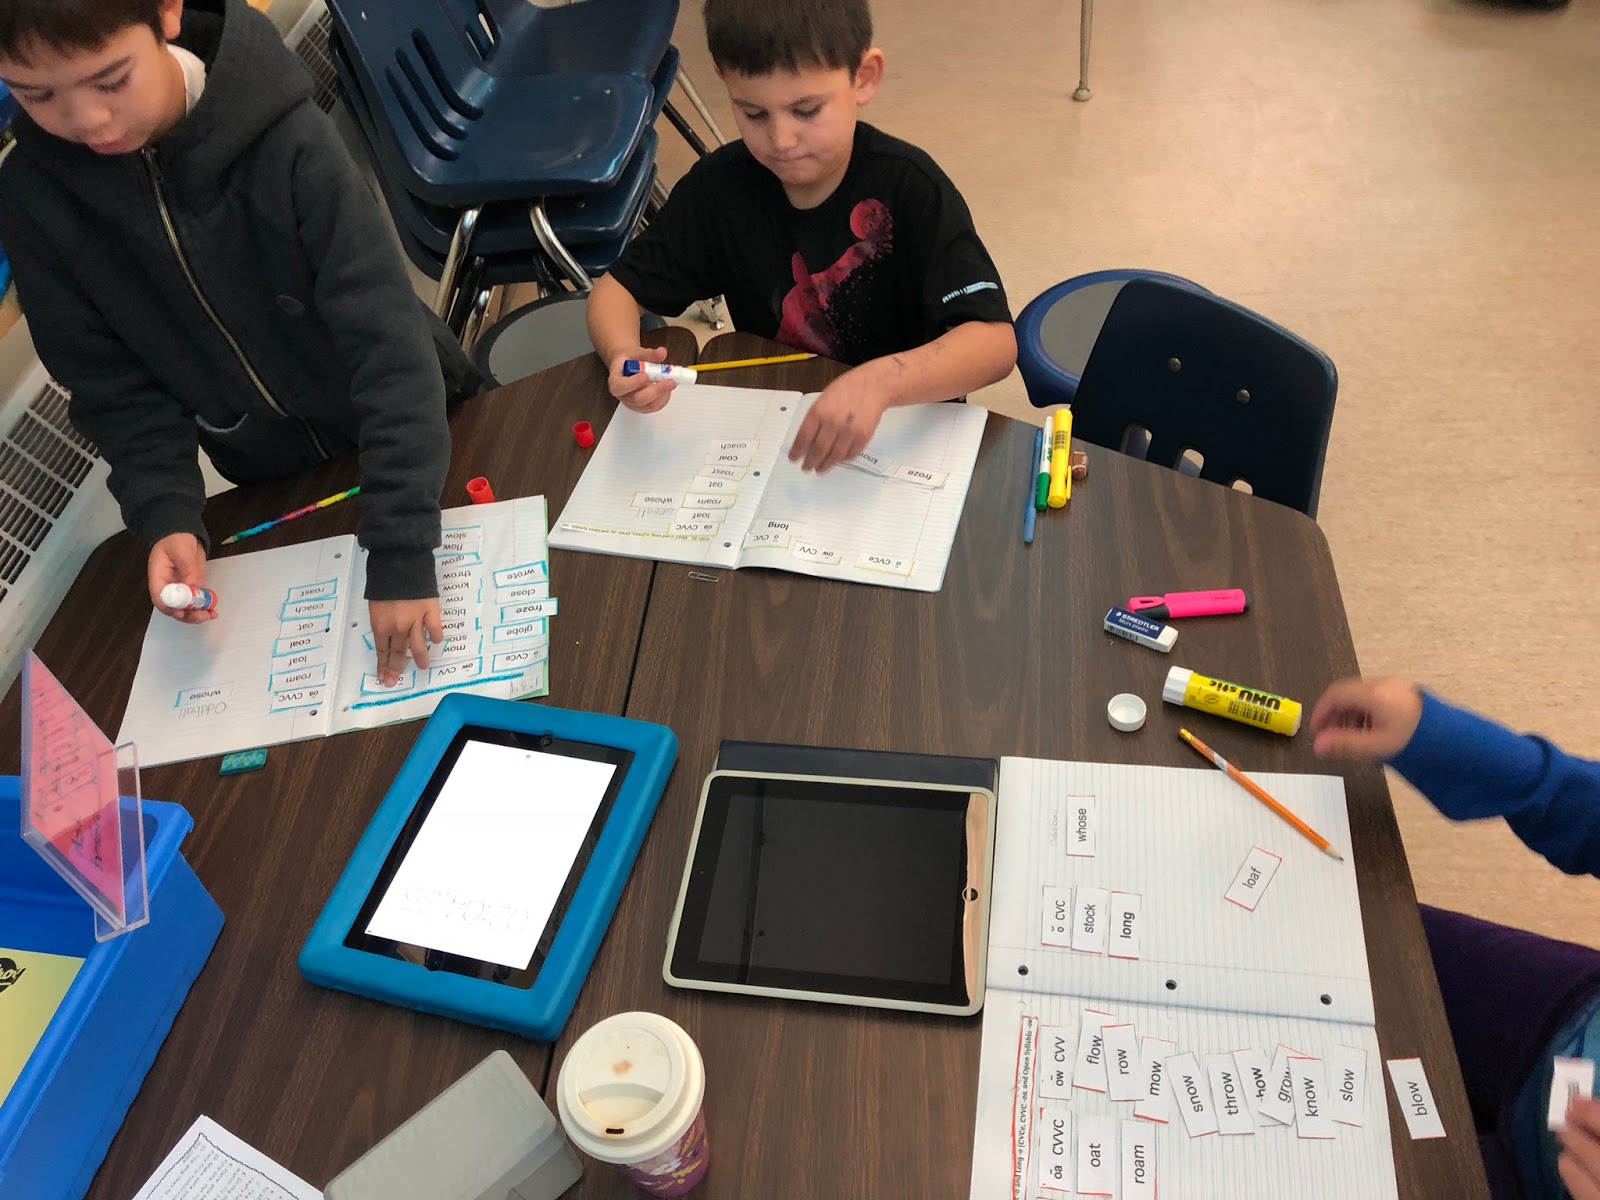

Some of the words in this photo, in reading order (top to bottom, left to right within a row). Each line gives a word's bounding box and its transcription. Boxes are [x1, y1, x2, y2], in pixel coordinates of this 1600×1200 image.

[712, 468, 734, 476] roast
[907, 469, 933, 481] froze
[644, 496, 673, 504] whose
[767, 521, 790, 531] long
[799, 546, 818, 555] CVV
[868, 556, 891, 565] CVCe
[442, 570, 471, 580] throw
[507, 568, 535, 580] wrote
[300, 587, 325, 596] roast
[443, 582, 470, 592] know
[510, 588, 536, 597] close
[295, 603, 324, 613] coach
[442, 608, 467, 616] blow
[516, 604, 542, 614] froze
[298, 622, 314, 630] oat
[506, 624, 533, 635] globe
[1121, 613, 1160, 632] STAEDTLER
[289, 638, 311, 649] coal
[448, 634, 467, 643] sno
[288, 655, 307, 667] loaf
[505, 653, 529, 661] CVCe
[285, 672, 312, 683] roam
[437, 666, 457, 677] CVV
[1209, 679, 1237, 694] stic
[189, 689, 221, 700] whose
[278, 692, 303, 702] CVVC
[1238, 689, 1281, 711] UHU
[178, 701, 227, 719] Oddball
[1076, 808, 1087, 843] whose
[1241, 866, 1262, 889] loaf
[1055, 899, 1066, 921] CVC
[1084, 903, 1096, 934] stock
[1120, 911, 1136, 939] long
[1025, 1033, 1033, 1057] Syllable
[1054, 1036, 1066, 1062] CVV
[1086, 1035, 1102, 1065] flow
[1023, 1056, 1032, 1075] Open
[1117, 1049, 1130, 1075] row
[1149, 1060, 1162, 1096] mow
[1251, 1067, 1266, 1102] how
[1339, 1068, 1356, 1102] slow
[1182, 1075, 1204, 1113] snow
[1222, 1071, 1239, 1116] throw
[1304, 1077, 1319, 1118] know
[1407, 1081, 1428, 1117] blow
[1052, 1119, 1065, 1156] CVVC
[1088, 1143, 1101, 1168] oat
[1016, 1157, 1025, 1173] Long
[1134, 1144, 1145, 1184] roam
